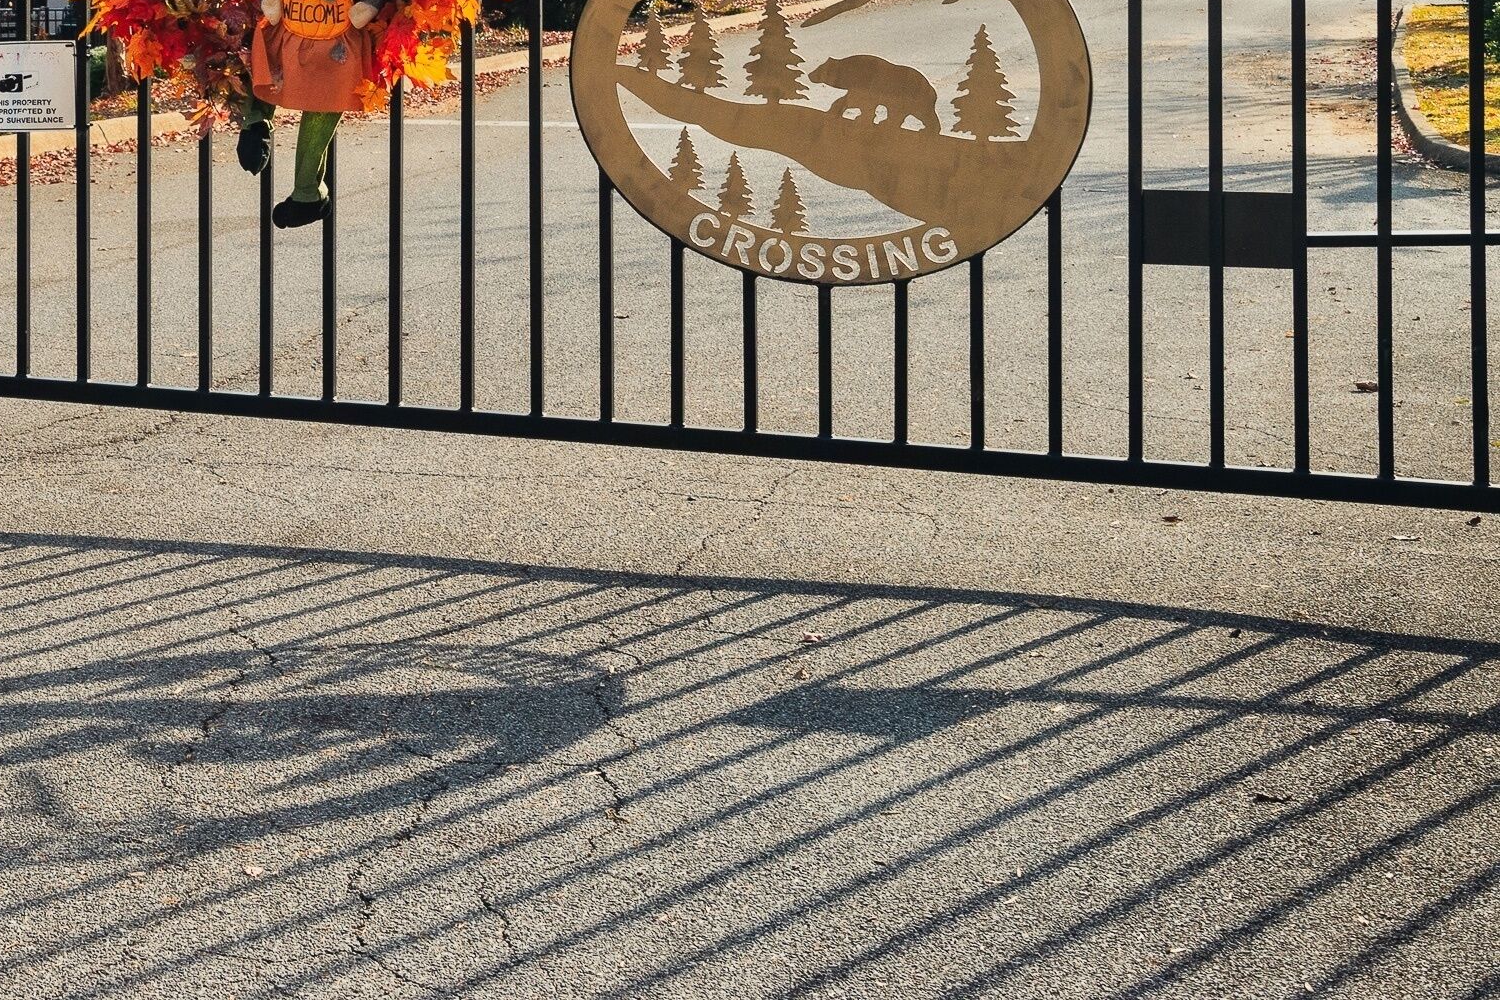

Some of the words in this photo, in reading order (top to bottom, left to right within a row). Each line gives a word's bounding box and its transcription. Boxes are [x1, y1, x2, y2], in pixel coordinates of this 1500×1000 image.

[283, 1, 346, 24] WELCOME
[7, 116, 64, 124] SURVEILLANCE
[688, 212, 959, 282] CROSSING
